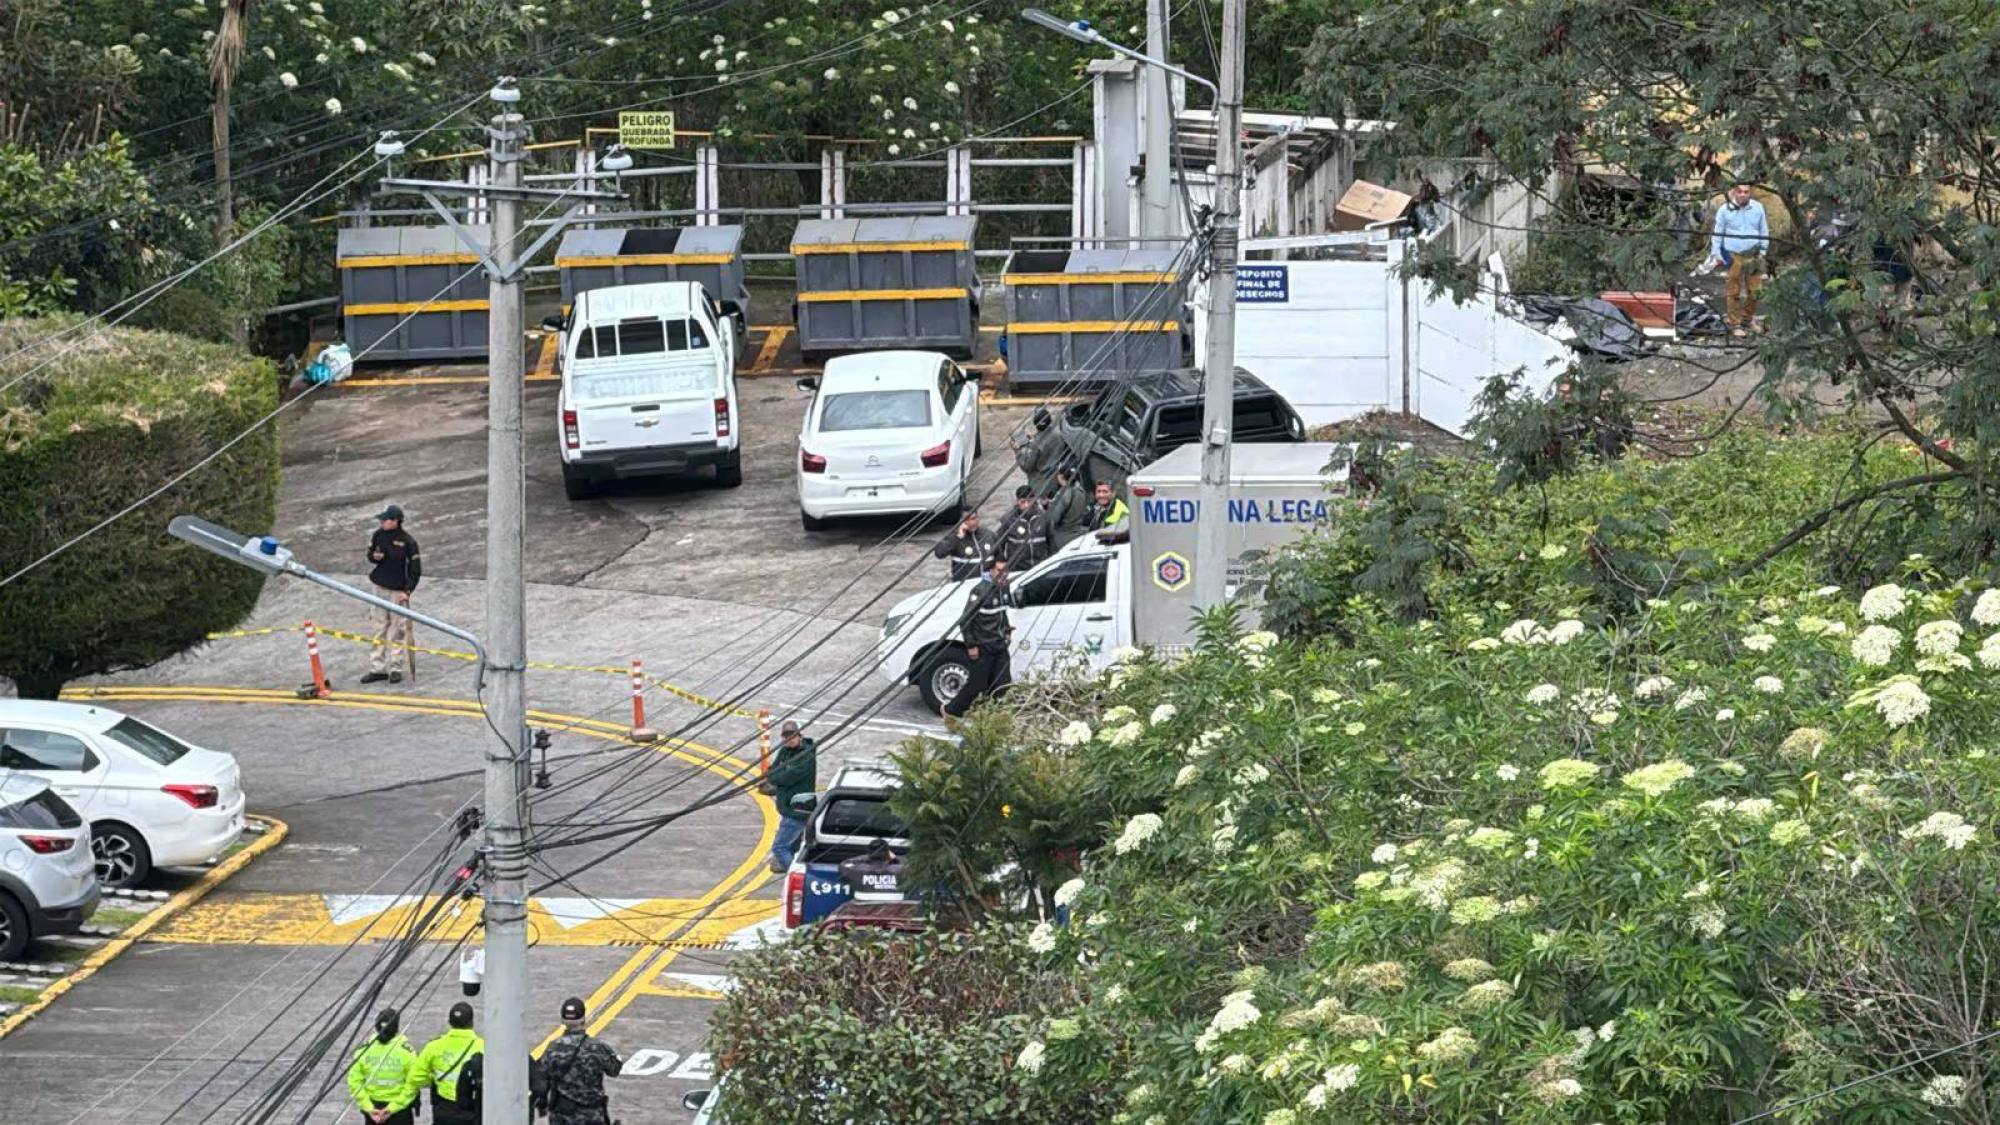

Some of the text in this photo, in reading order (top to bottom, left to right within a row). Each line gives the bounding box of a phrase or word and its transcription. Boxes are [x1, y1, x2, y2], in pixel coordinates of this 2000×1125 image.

[622, 115, 671, 126] PELIGRO
[622, 128, 671, 136] QUEBRADA
[622, 137, 671, 145] PROFUNDA
[1237, 280, 1281, 288] FINAL DE
[1233, 290, 1285, 298] DESECHOS
[1144, 499, 1328, 523] MEDINA LEGA
[863, 874, 897, 885] POLICIA
[821, 882, 851, 895] 911
